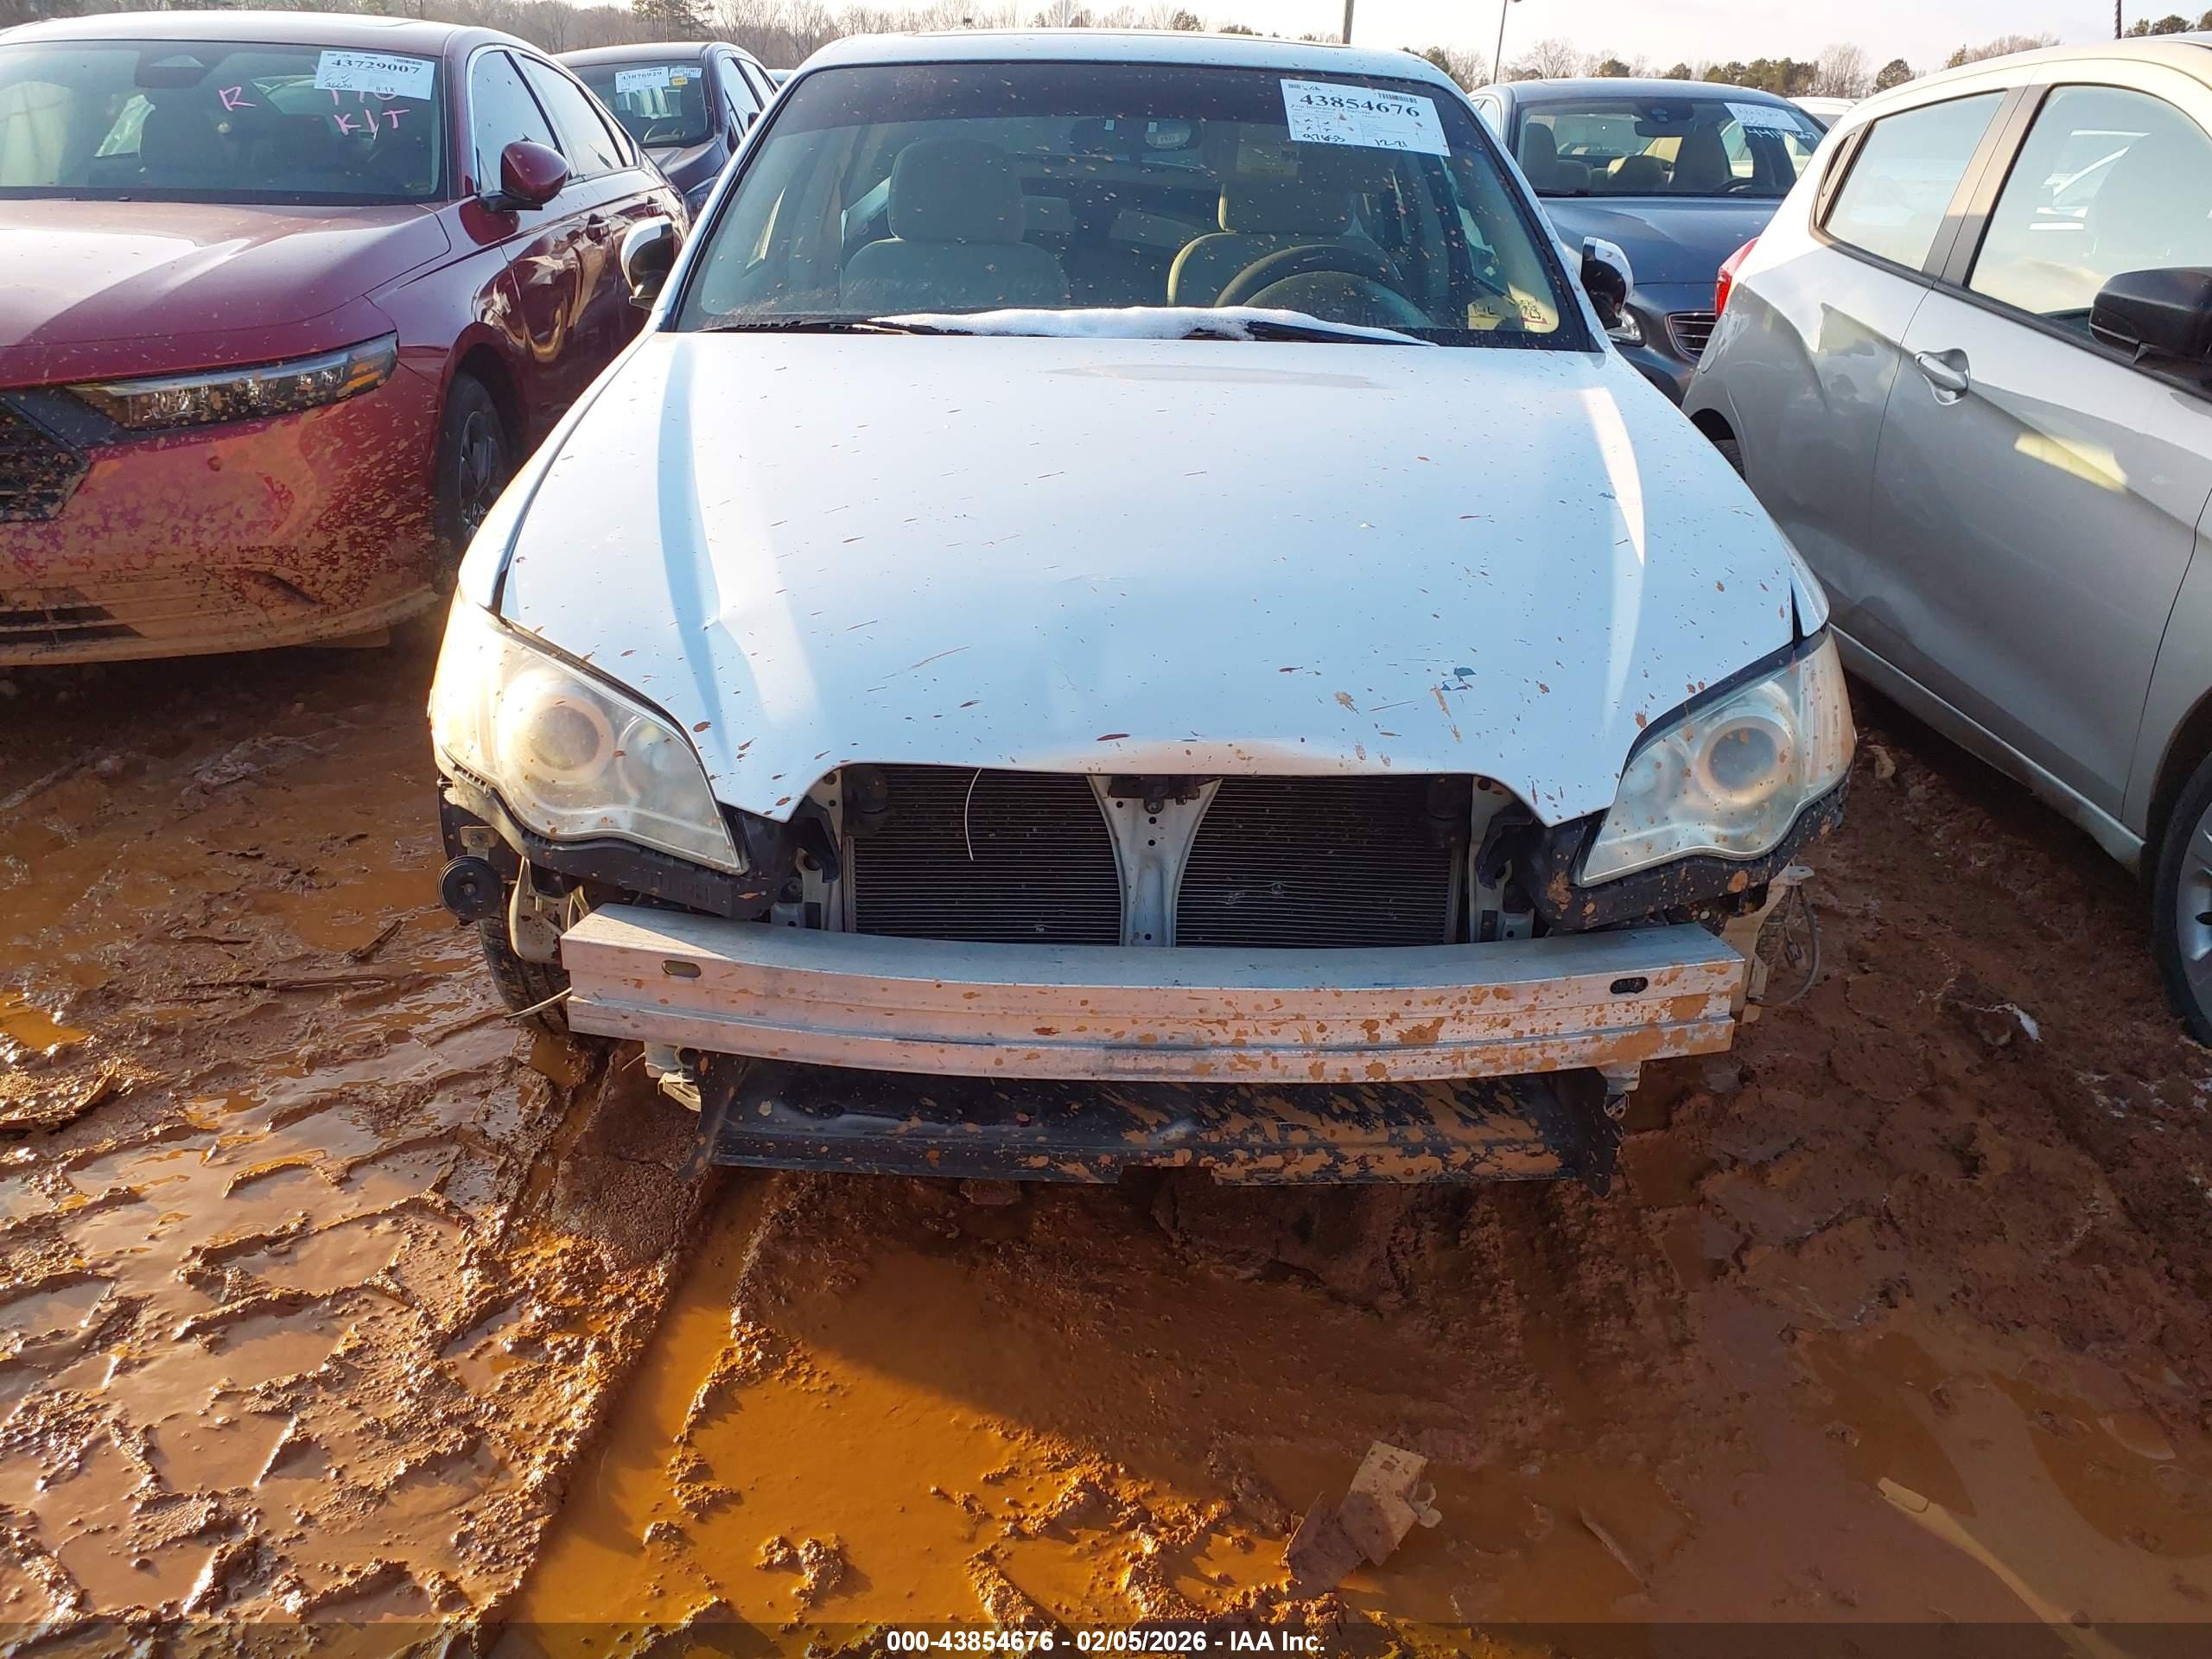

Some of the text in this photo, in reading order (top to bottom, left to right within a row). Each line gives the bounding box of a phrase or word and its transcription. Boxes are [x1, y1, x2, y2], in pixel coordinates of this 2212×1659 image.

[332, 59, 421, 74] 43729007
[1300, 93, 1420, 118] 43854676
[333, 108, 410, 136] KIT
